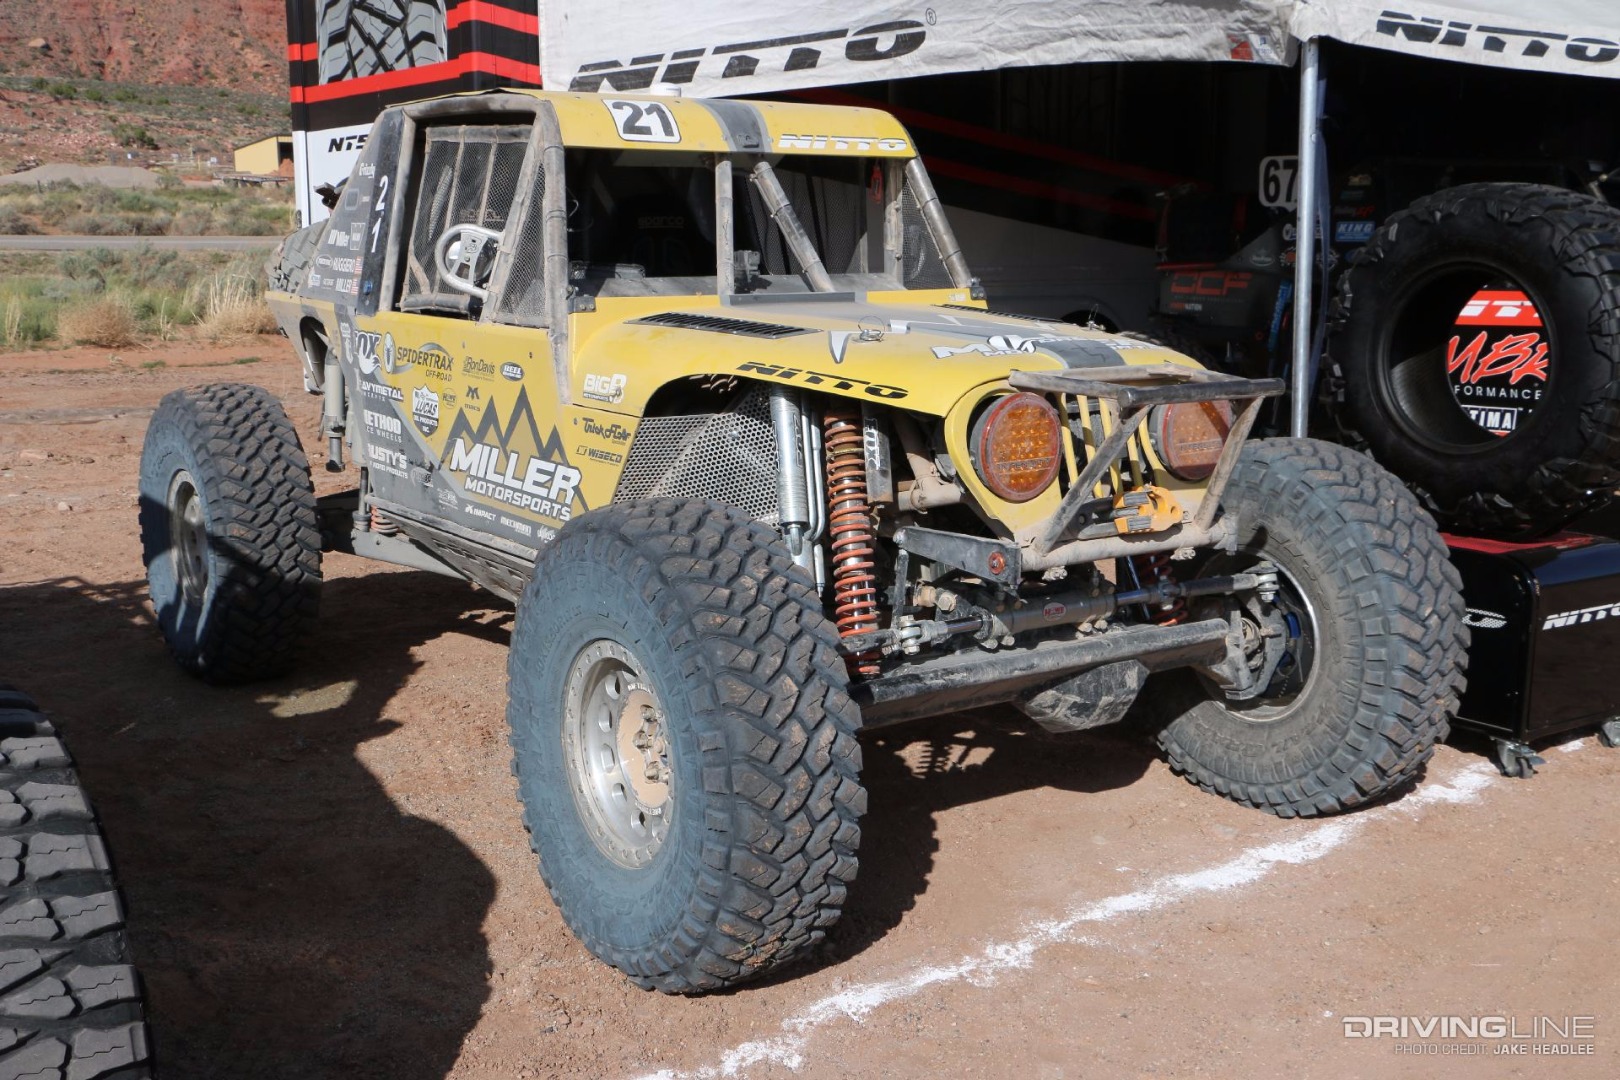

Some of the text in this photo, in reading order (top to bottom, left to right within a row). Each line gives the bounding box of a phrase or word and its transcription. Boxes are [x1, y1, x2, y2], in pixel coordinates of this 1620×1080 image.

[1376, 9, 1620, 63] NITTO
[568, 19, 927, 92] NITTO
[611, 101, 675, 137] 21
[777, 134, 907, 152] NITTO
[396, 346, 454, 372] SPIDERTRAX
[736, 361, 909, 399] NITTO
[1454, 384, 1543, 400] FORMANCE
[415, 401, 438, 416] LUCAS
[1469, 409, 1512, 429] TIMA
[449, 437, 582, 505] MILLER
[464, 477, 572, 521] MOTORSPORTS
